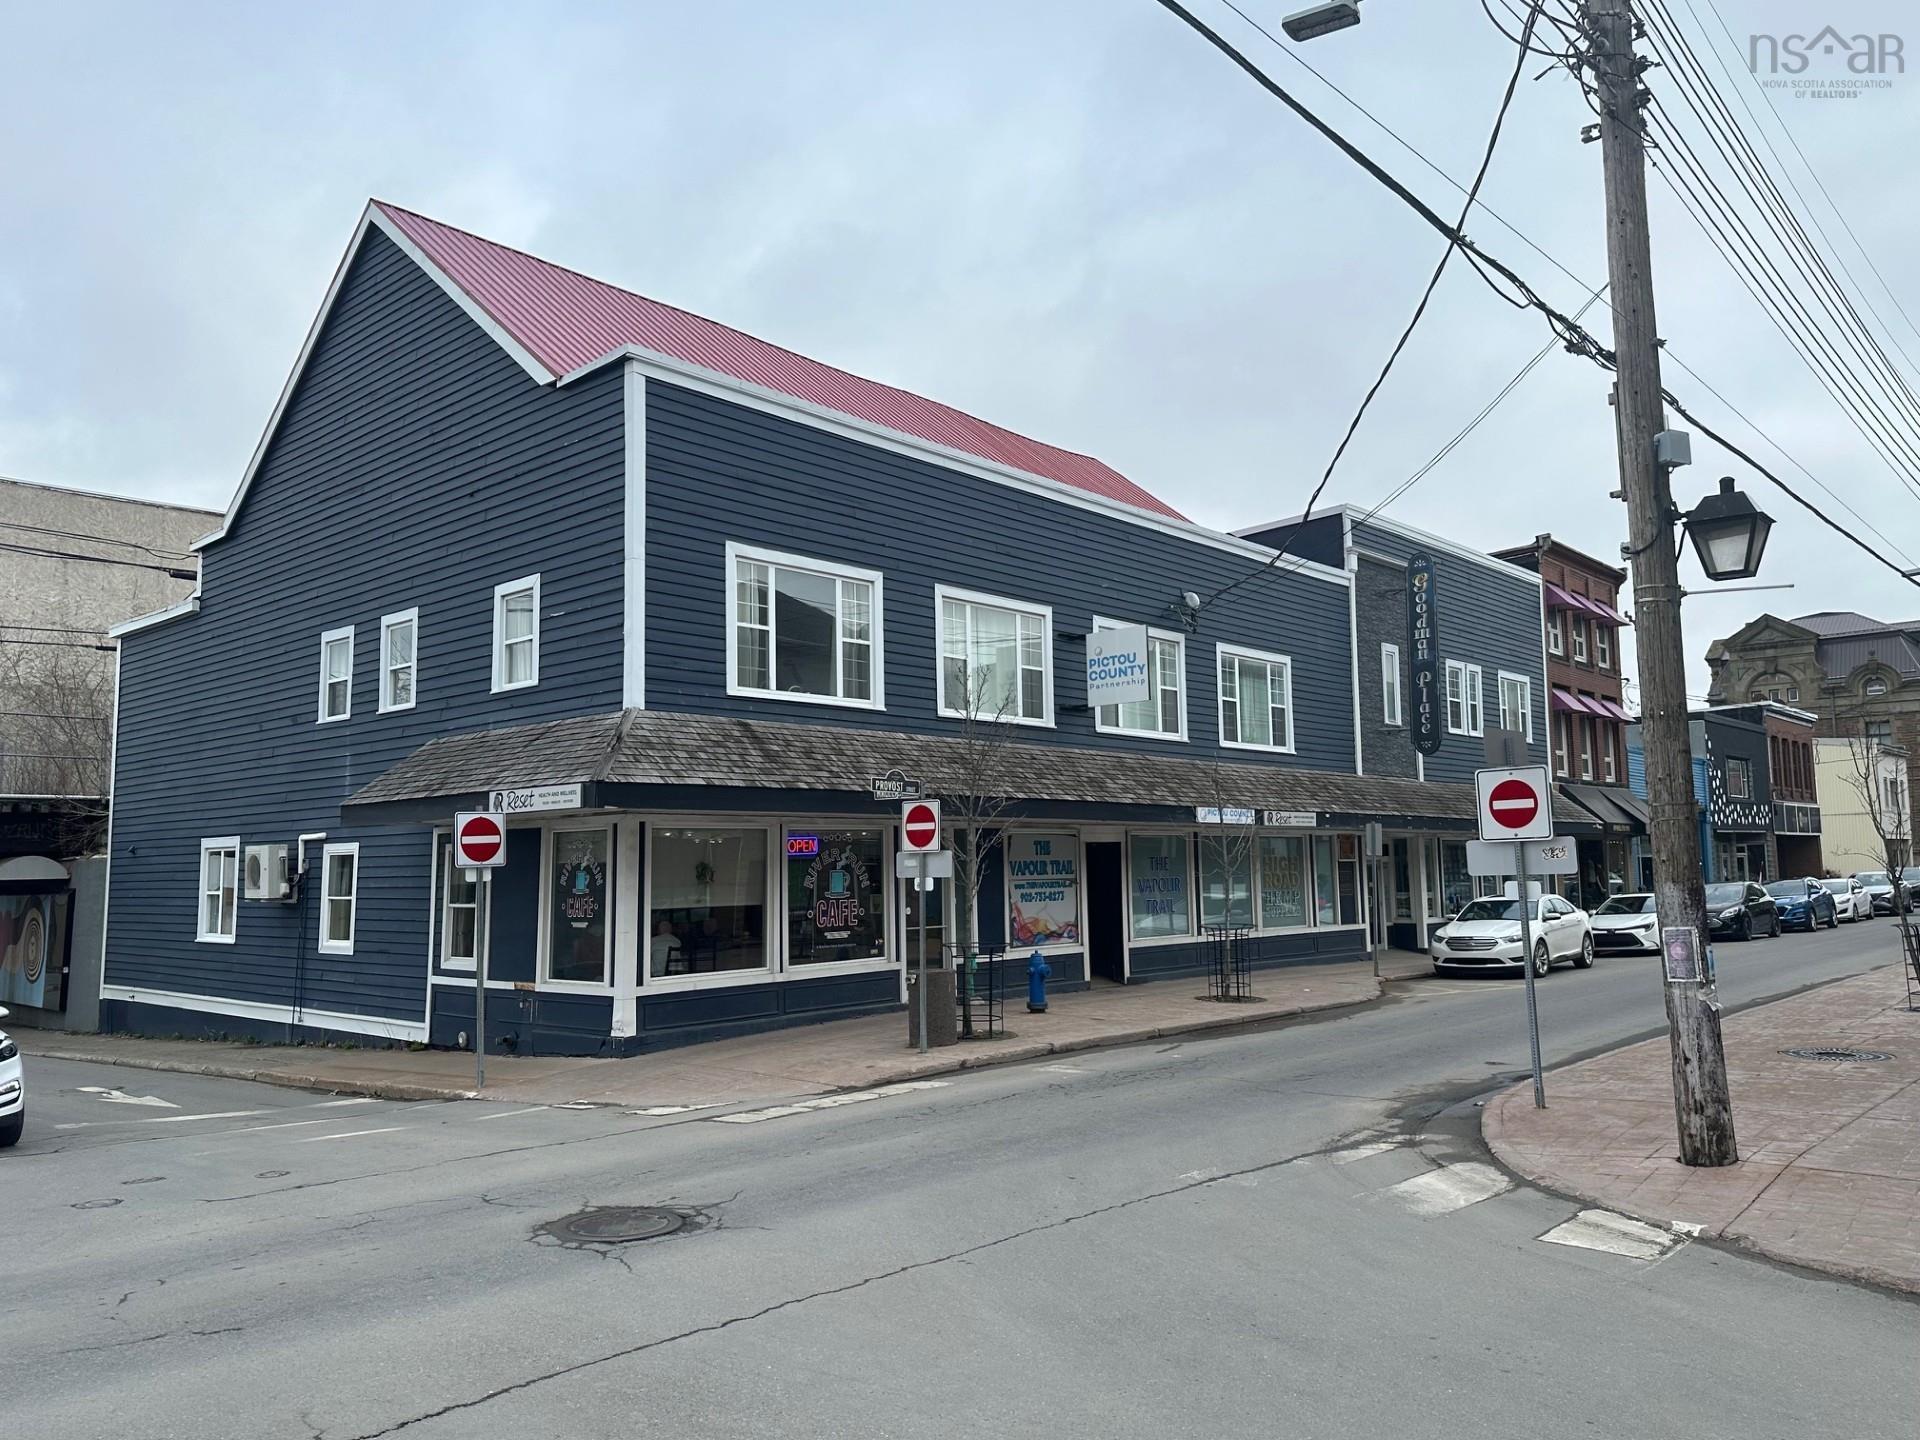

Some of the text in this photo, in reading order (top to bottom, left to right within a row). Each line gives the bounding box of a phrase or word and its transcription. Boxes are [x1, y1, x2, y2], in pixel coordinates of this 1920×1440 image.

[1089, 652, 1137, 669] PICTOU
[1412, 572, 1432, 734] Goodman Place
[1089, 664, 1146, 682] COUNTY
[1089, 678, 1146, 690] Partnership
[875, 780, 903, 791] PROVOST
[507, 789, 535, 811] Reset
[787, 839, 817, 853] OPEN
[1033, 840, 1051, 855] THE
[804, 848, 840, 888] RIVER
[1009, 860, 1075, 876] VAPOUR TRAIL
[1147, 856, 1169, 871] THE
[1263, 856, 1299, 871] HIGH
[1137, 877, 1181, 893] VAPOUR
[1263, 872, 1300, 888] ROAD
[816, 899, 858, 928] CAFE
[1146, 898, 1176, 914] TRAIL
